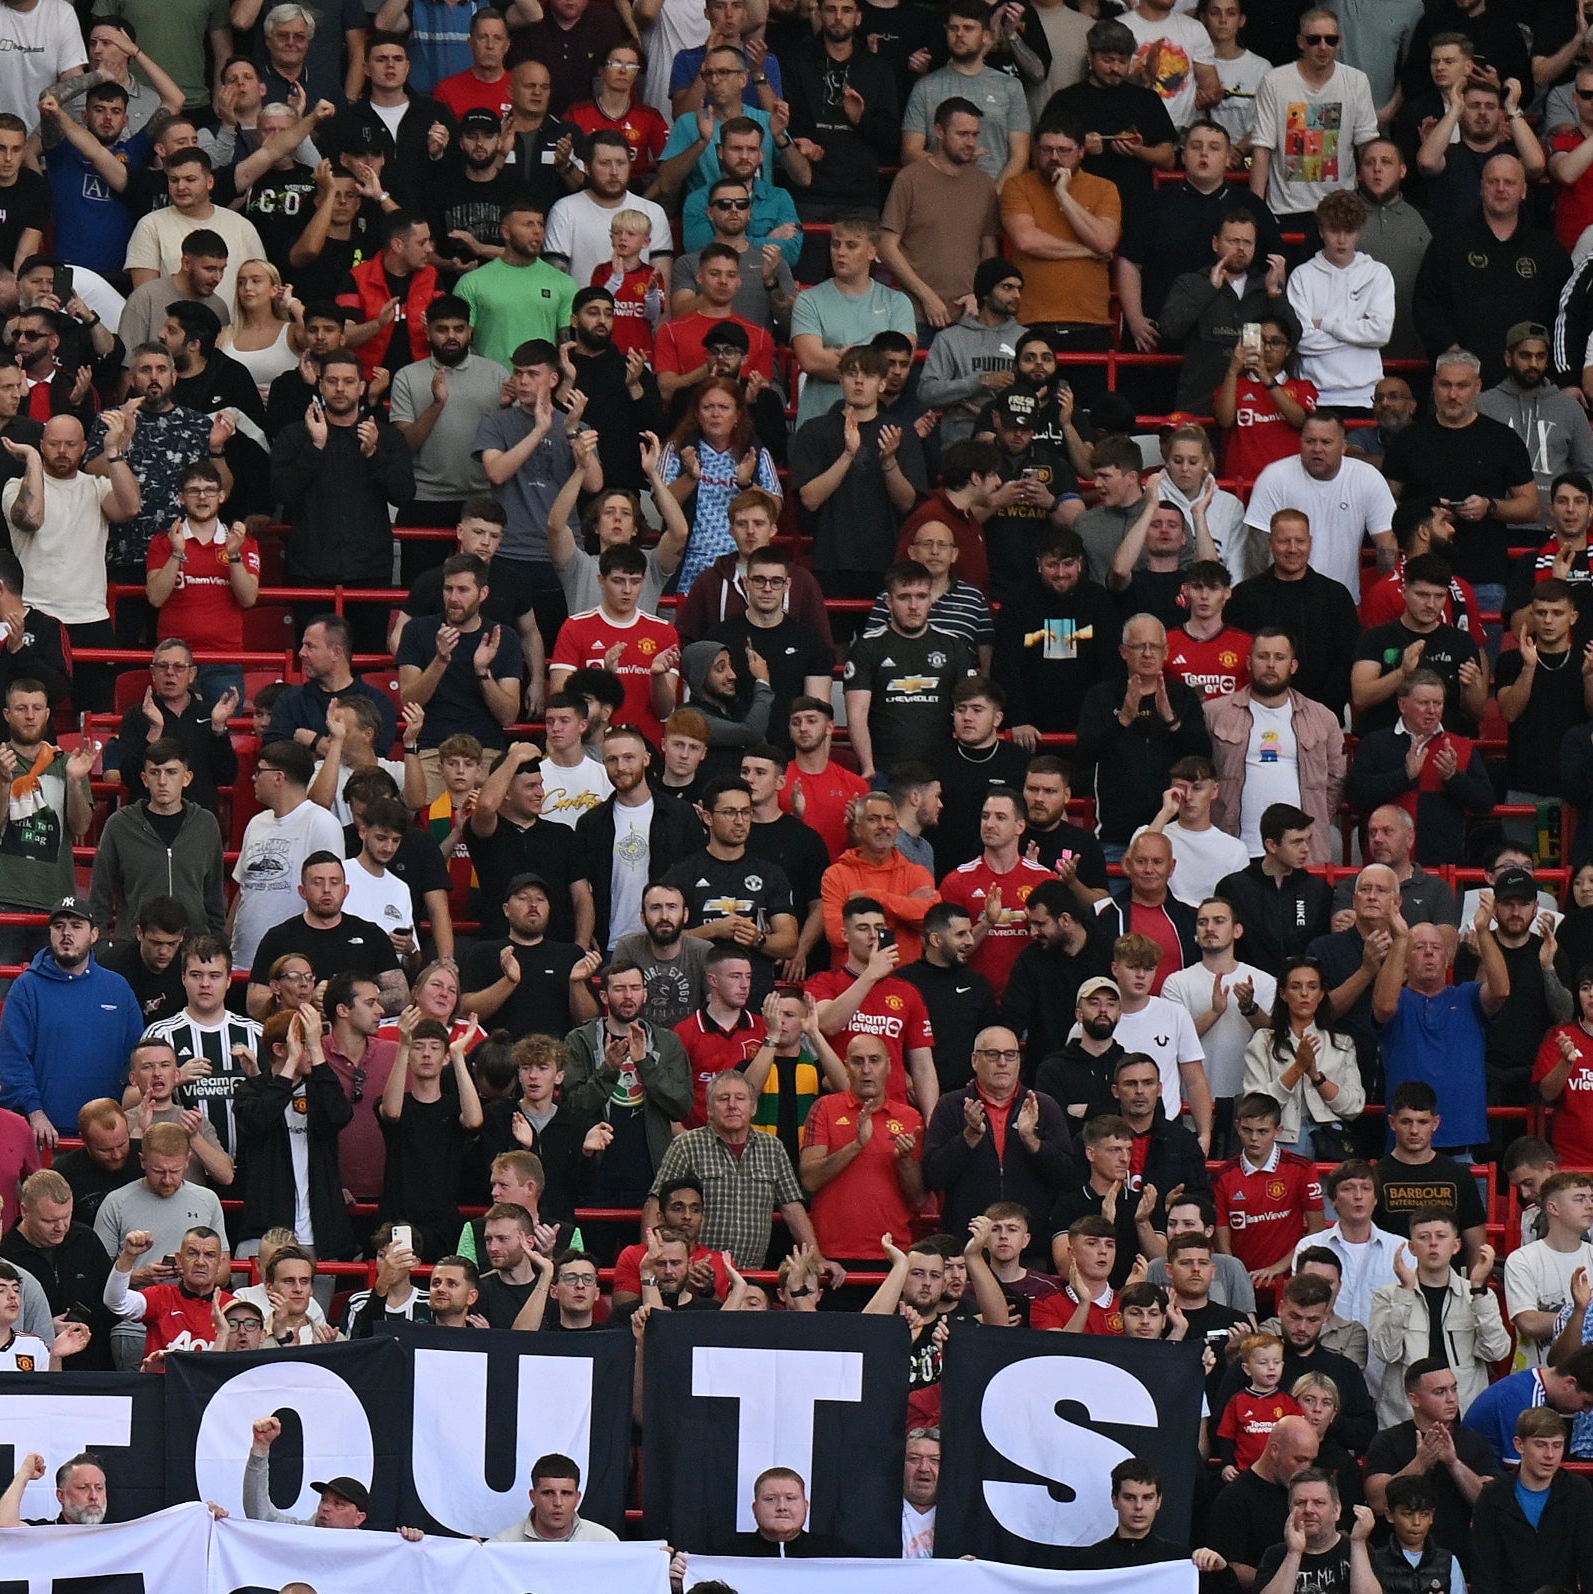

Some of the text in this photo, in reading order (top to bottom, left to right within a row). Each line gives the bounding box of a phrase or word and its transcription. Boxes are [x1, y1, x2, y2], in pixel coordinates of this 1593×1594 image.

[1181, 671, 1220, 687] Team
[886, 693, 940, 705] CHEVROLET
[24, 832, 47, 846] Hag
[61, 896, 75, 907] NY
[1295, 900, 1306, 927] NIKE
[184, 1082, 229, 1096] Viewer
[1390, 1186, 1452, 1201] BARBOUR
